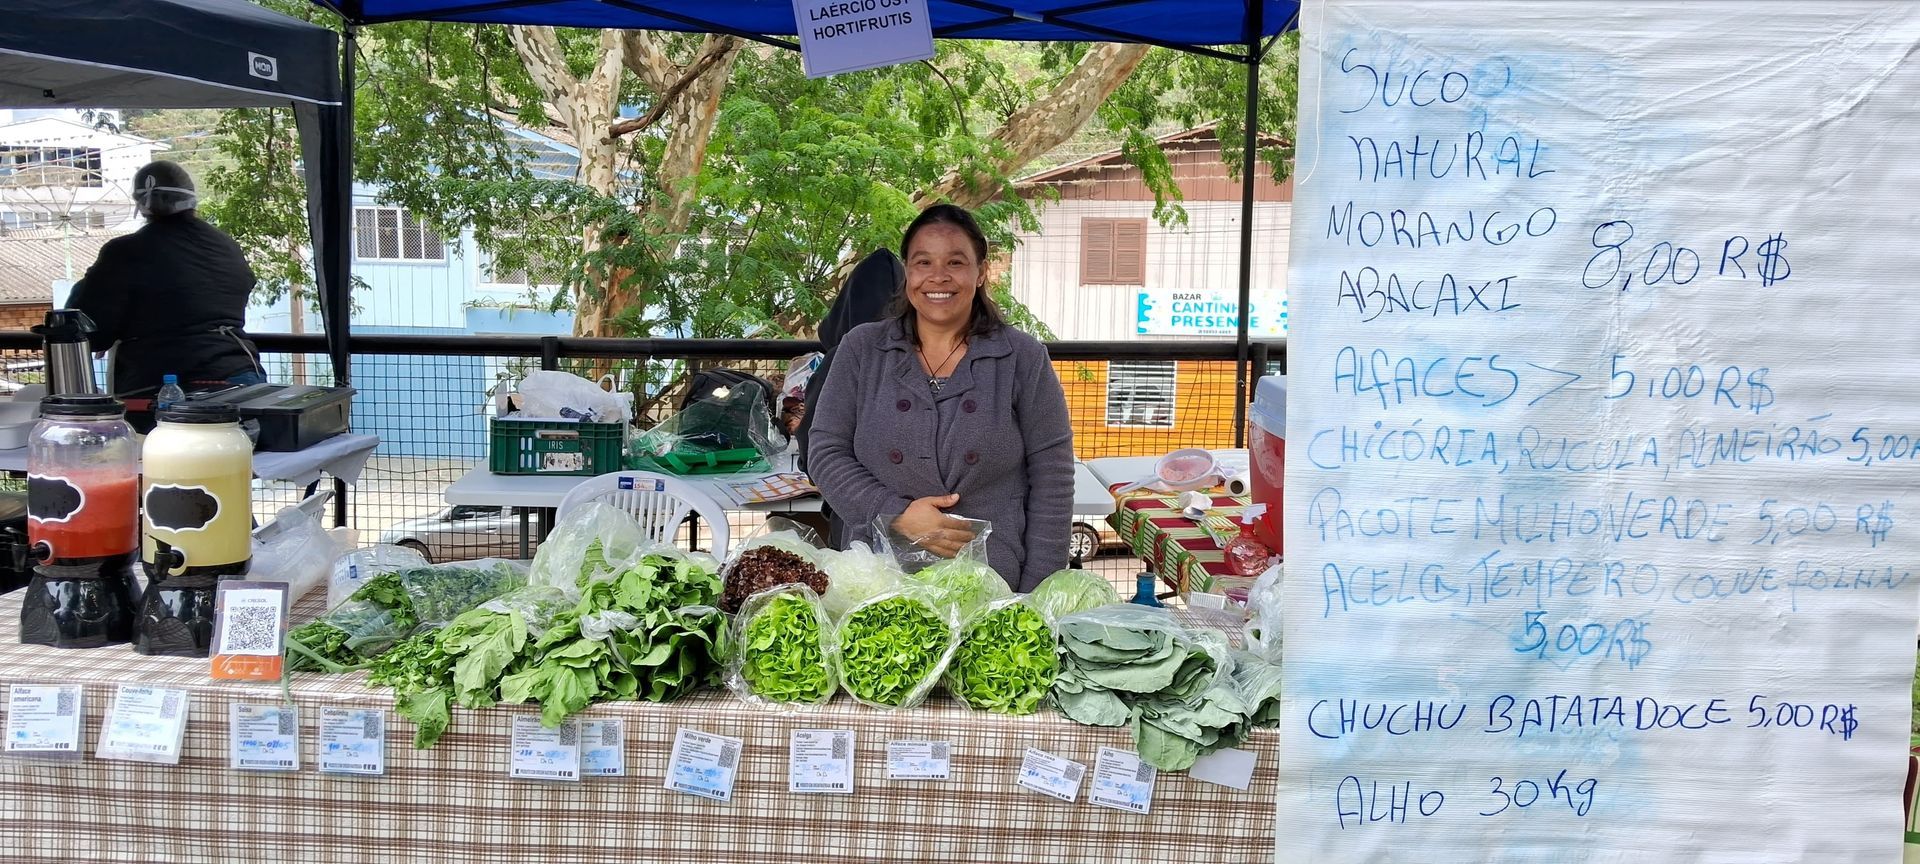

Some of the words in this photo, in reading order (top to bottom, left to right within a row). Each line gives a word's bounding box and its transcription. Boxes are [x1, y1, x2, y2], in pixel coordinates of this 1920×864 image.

[809, 0, 876, 21] LAÉRCIO
[813, 11, 913, 40] HORTIFRUTIS
[1339, 48, 1468, 113] SUCO
[1327, 201, 1556, 248] MORANGO
[1582, 220, 1700, 291] 8,00
[1719, 232, 1791, 287] R$
[1172, 293, 1202, 301] BAZAR
[1337, 266, 1522, 323] ABACAXI
[1171, 315, 1259, 328] PRESENE
[548, 440, 564, 450] IRIS
[1308, 486, 1463, 542] PACOTE
[684, 732, 698, 741] Milho
[1308, 698, 1467, 738] CHUCHU
[1337, 775, 1445, 829] ALHO
